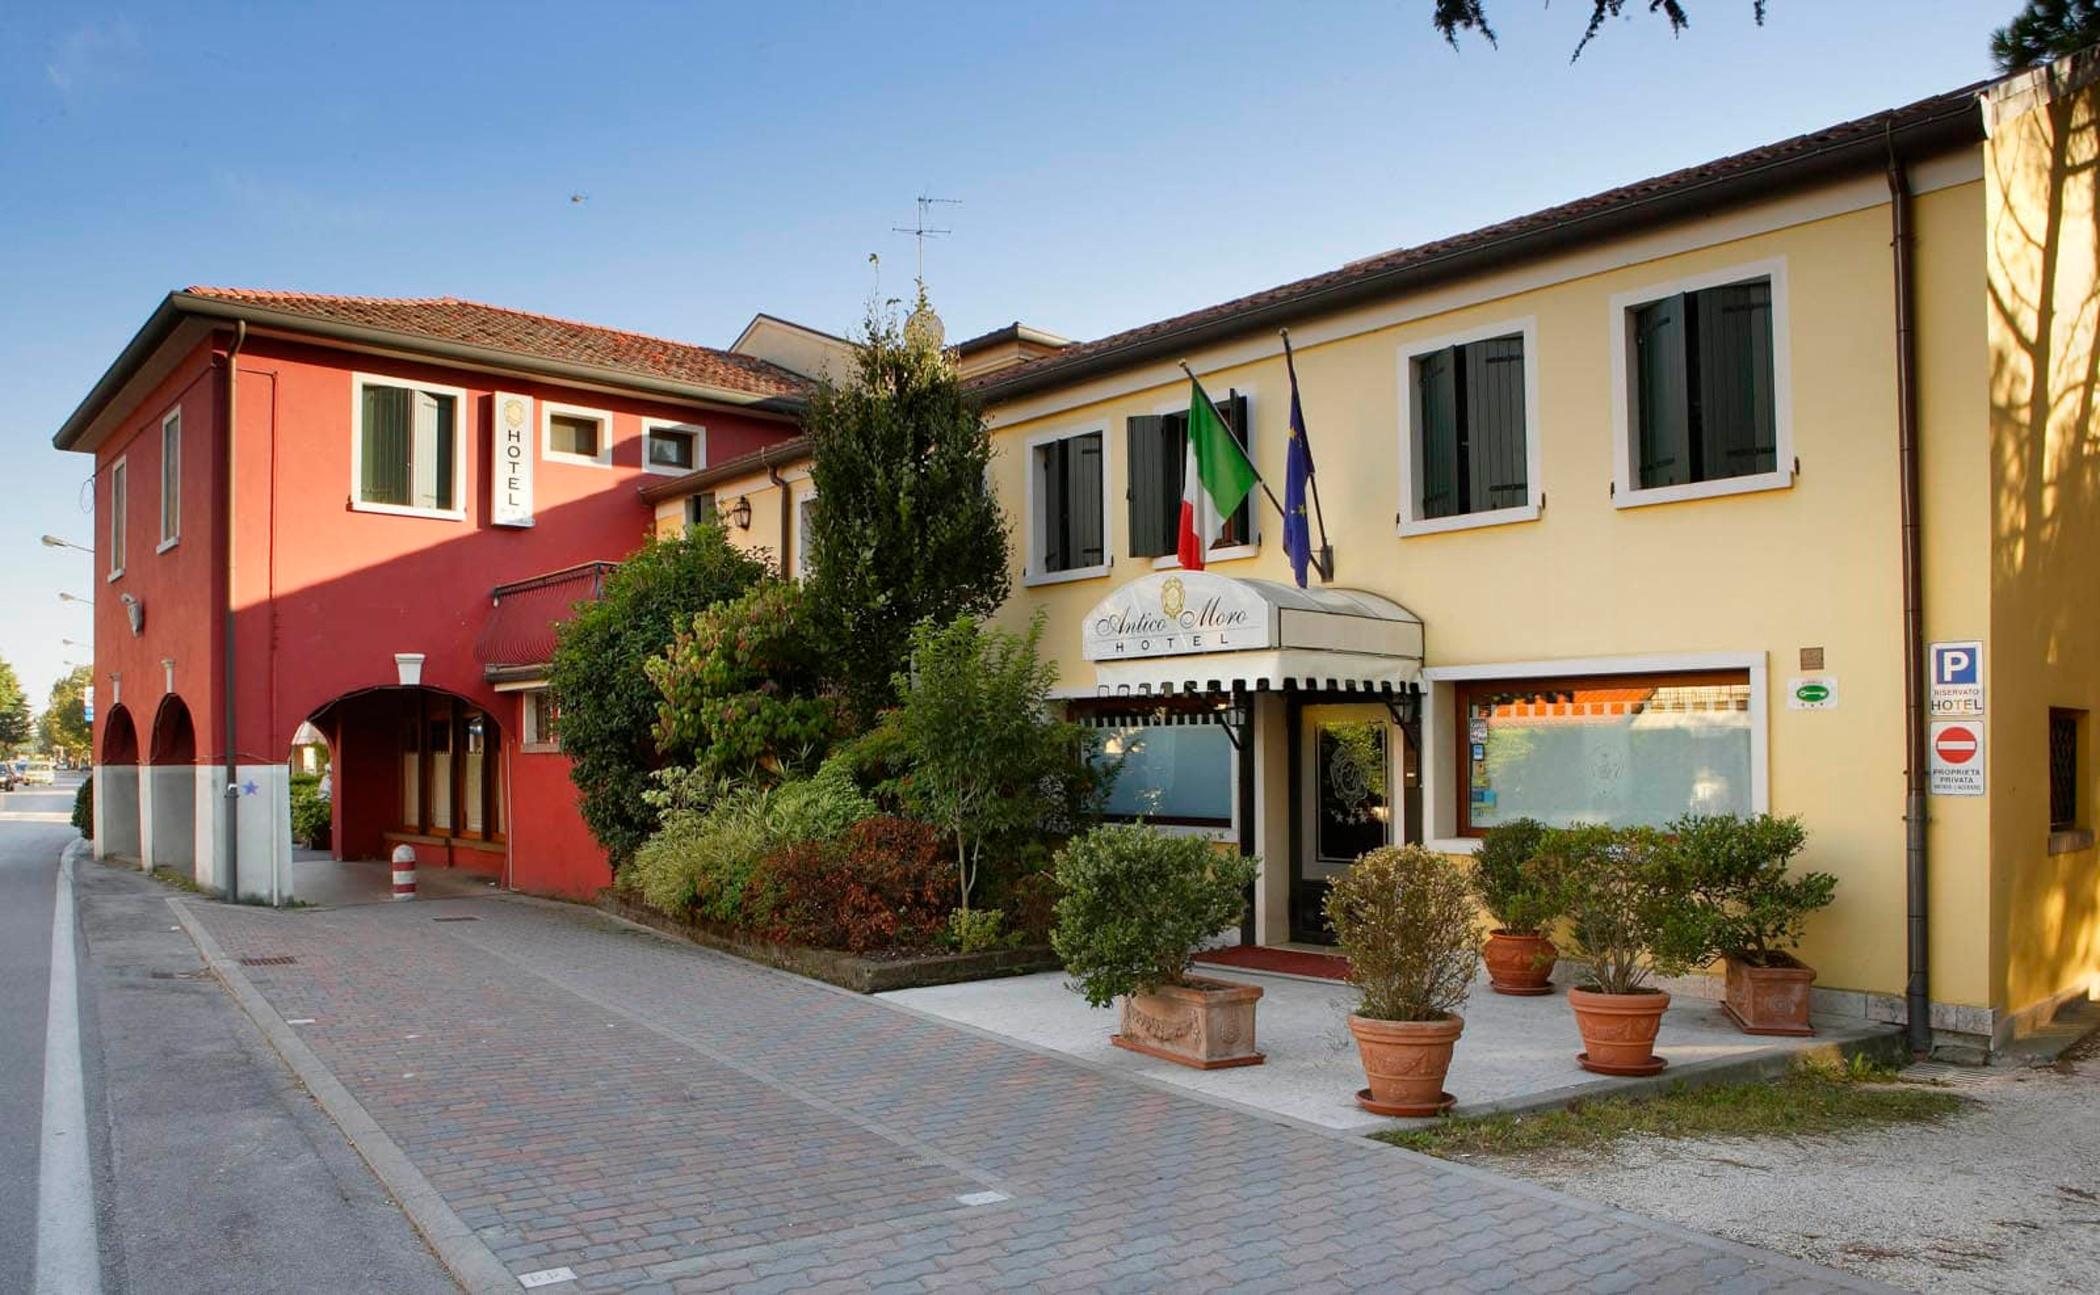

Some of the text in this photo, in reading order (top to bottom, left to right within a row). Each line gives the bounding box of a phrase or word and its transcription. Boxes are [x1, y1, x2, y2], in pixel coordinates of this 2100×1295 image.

[507, 430, 521, 506] HOTEL
[1096, 596, 1247, 636] Antico Moro
[1116, 633, 1228, 652] HOTEL
[1943, 651, 1969, 682] P
[1931, 699, 1983, 711] HOTEL
[1934, 688, 1980, 697] RISERVATO
